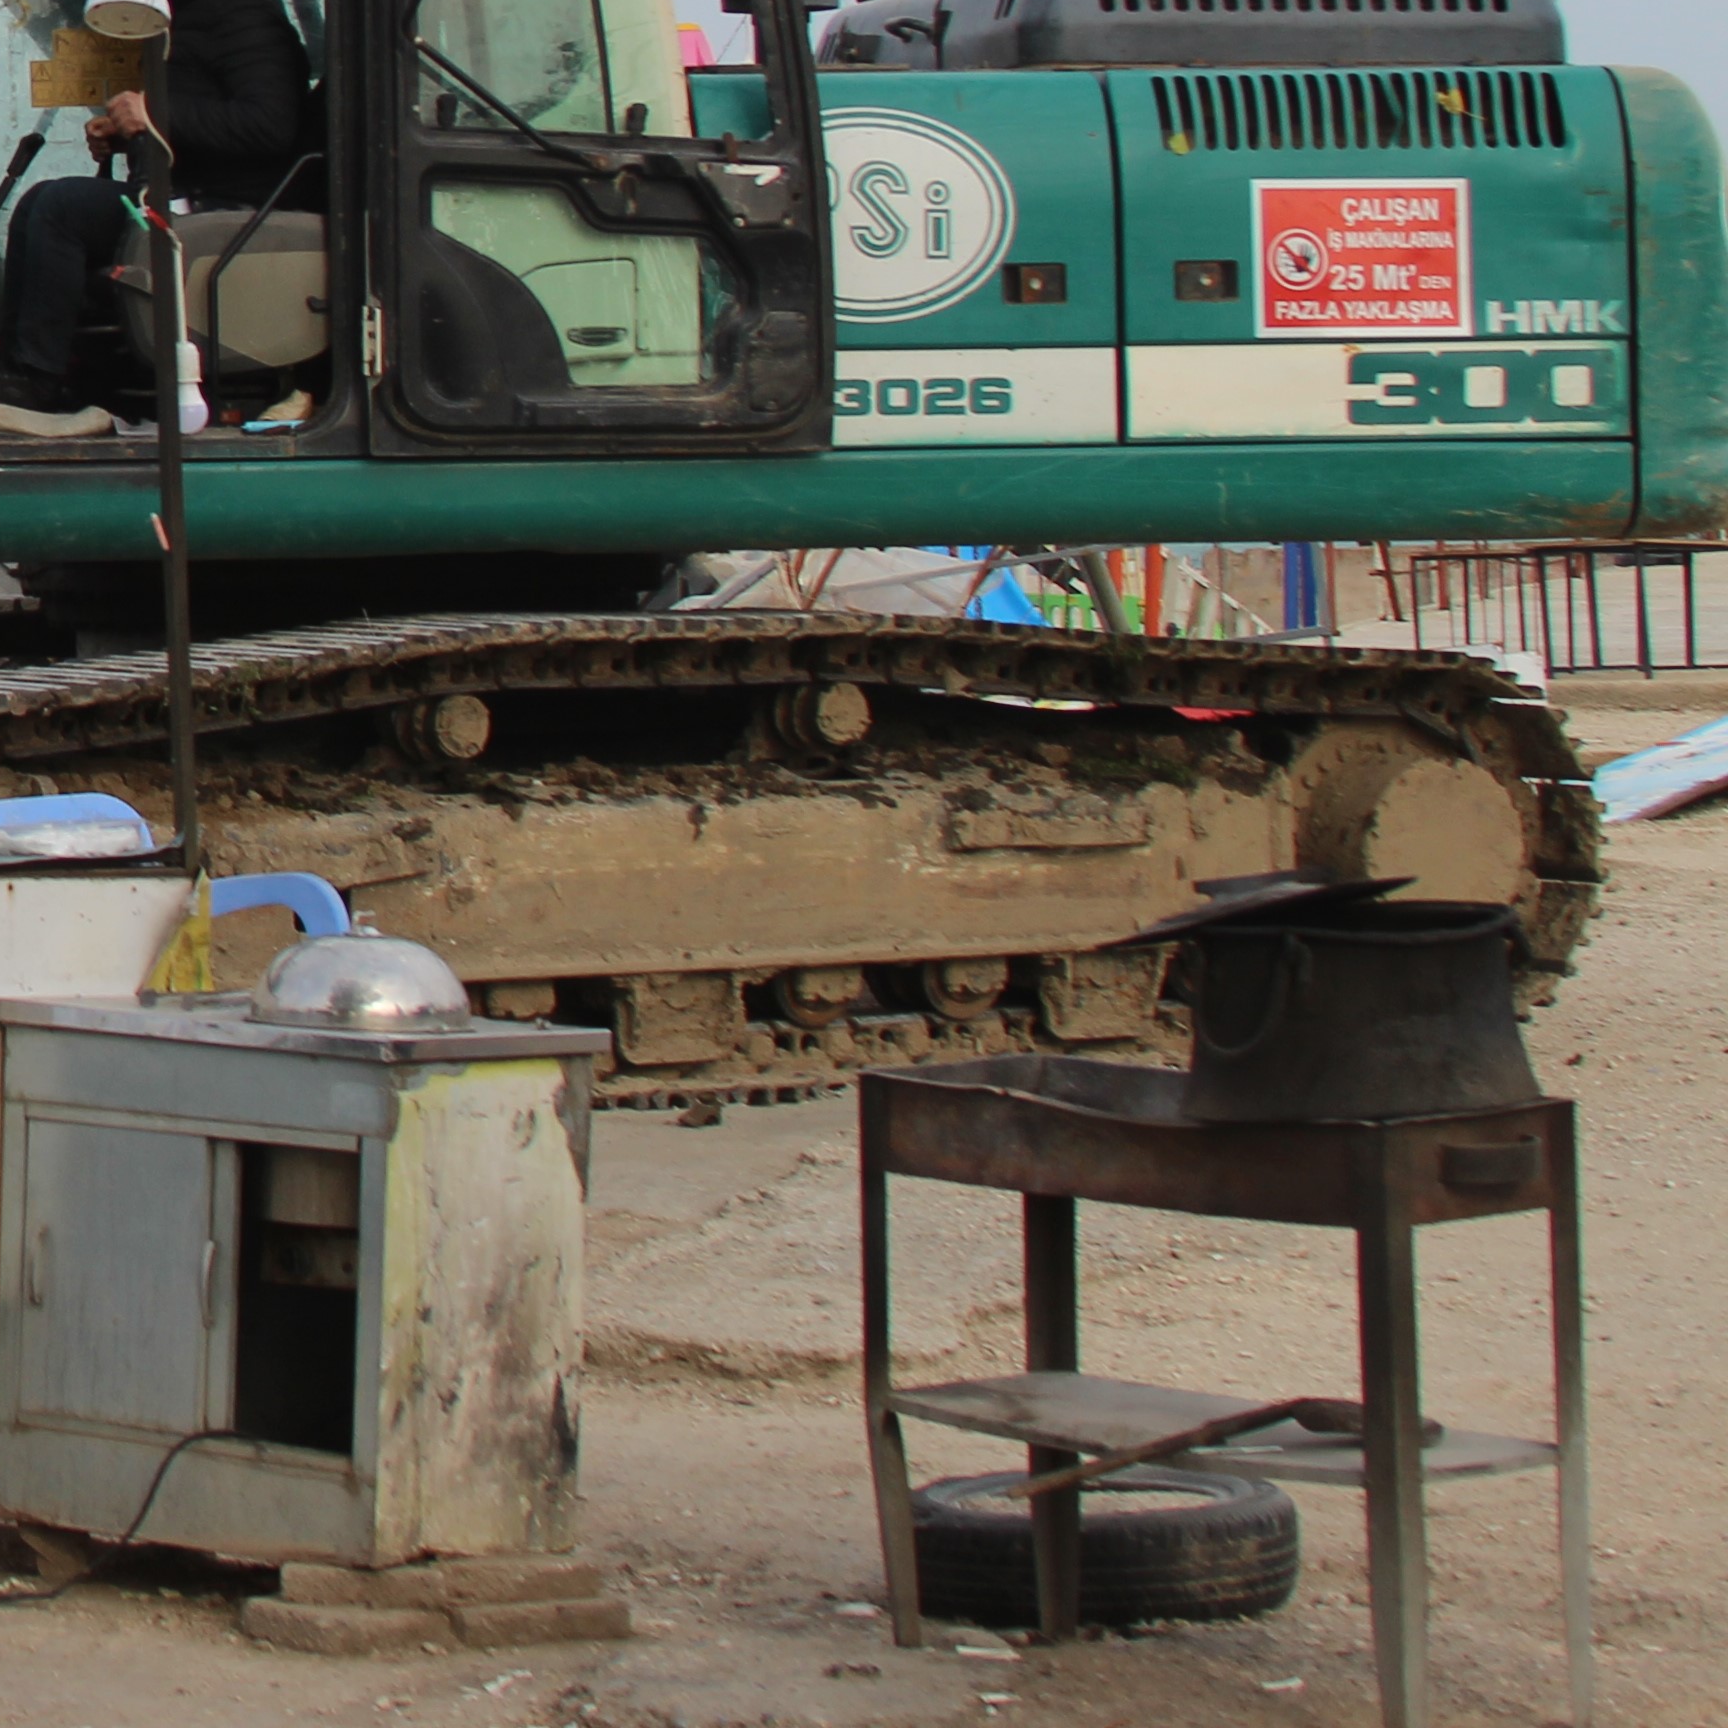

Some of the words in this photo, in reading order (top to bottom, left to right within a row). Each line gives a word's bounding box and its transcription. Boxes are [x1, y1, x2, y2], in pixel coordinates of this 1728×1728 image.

[1341, 198, 1439, 226] ÇALIŞAN
[1327, 227, 1343, 253] İŞ
[1346, 227, 1454, 249] MAKİNALARINA
[1329, 264, 1366, 291] 25
[1418, 275, 1452, 290] DEN
[1274, 300, 1341, 320] FAZLA
[1344, 300, 1454, 323] YAKLAŞMA
[1485, 299, 1626, 334] HMK
[834, 377, 1012, 416] 3026
[1348, 349, 1616, 424] 300
